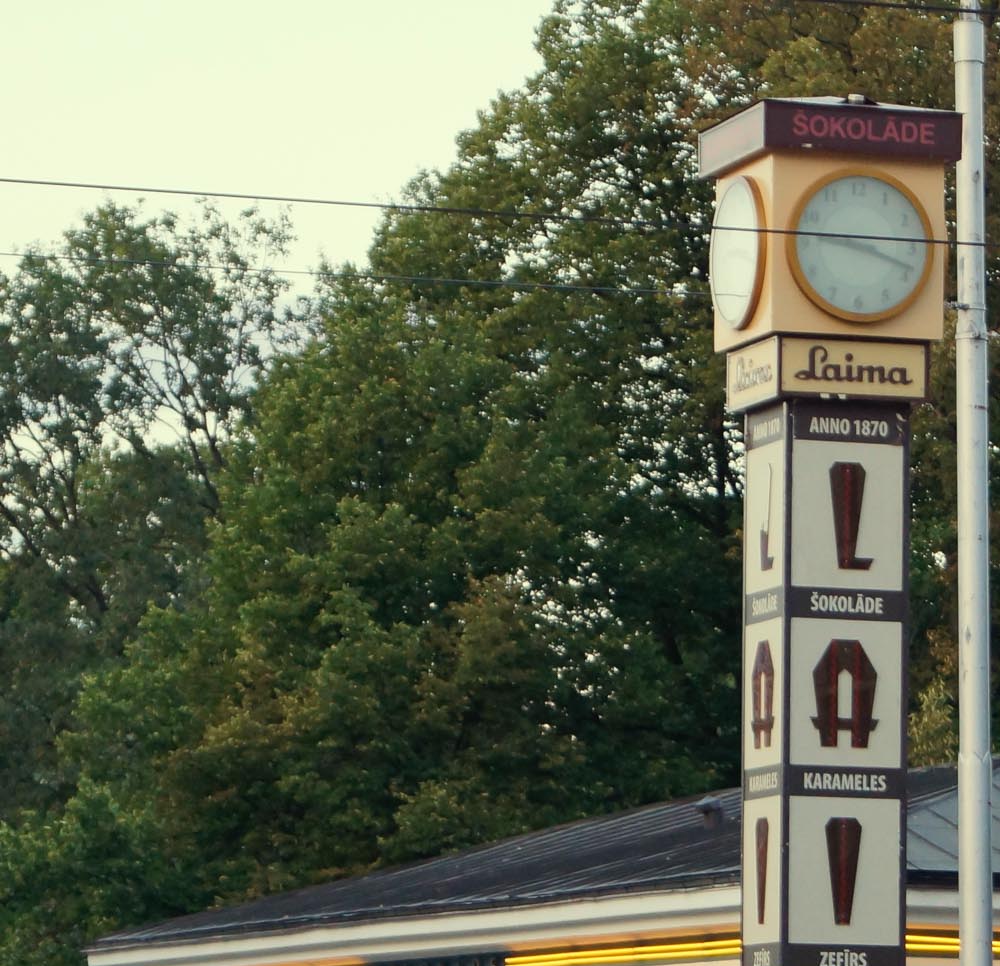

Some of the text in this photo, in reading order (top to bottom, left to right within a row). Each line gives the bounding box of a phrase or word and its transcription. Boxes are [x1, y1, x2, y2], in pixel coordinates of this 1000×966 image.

[792, 109, 936, 145] ŠOKOLĀDE
[851, 182, 866, 196] 12
[794, 345, 913, 386] Laima
[809, 416, 889, 437] ANNO 1870
[810, 591, 884, 614] ŠOKOLĀDE
[803, 772, 887, 792] KARAMELES
